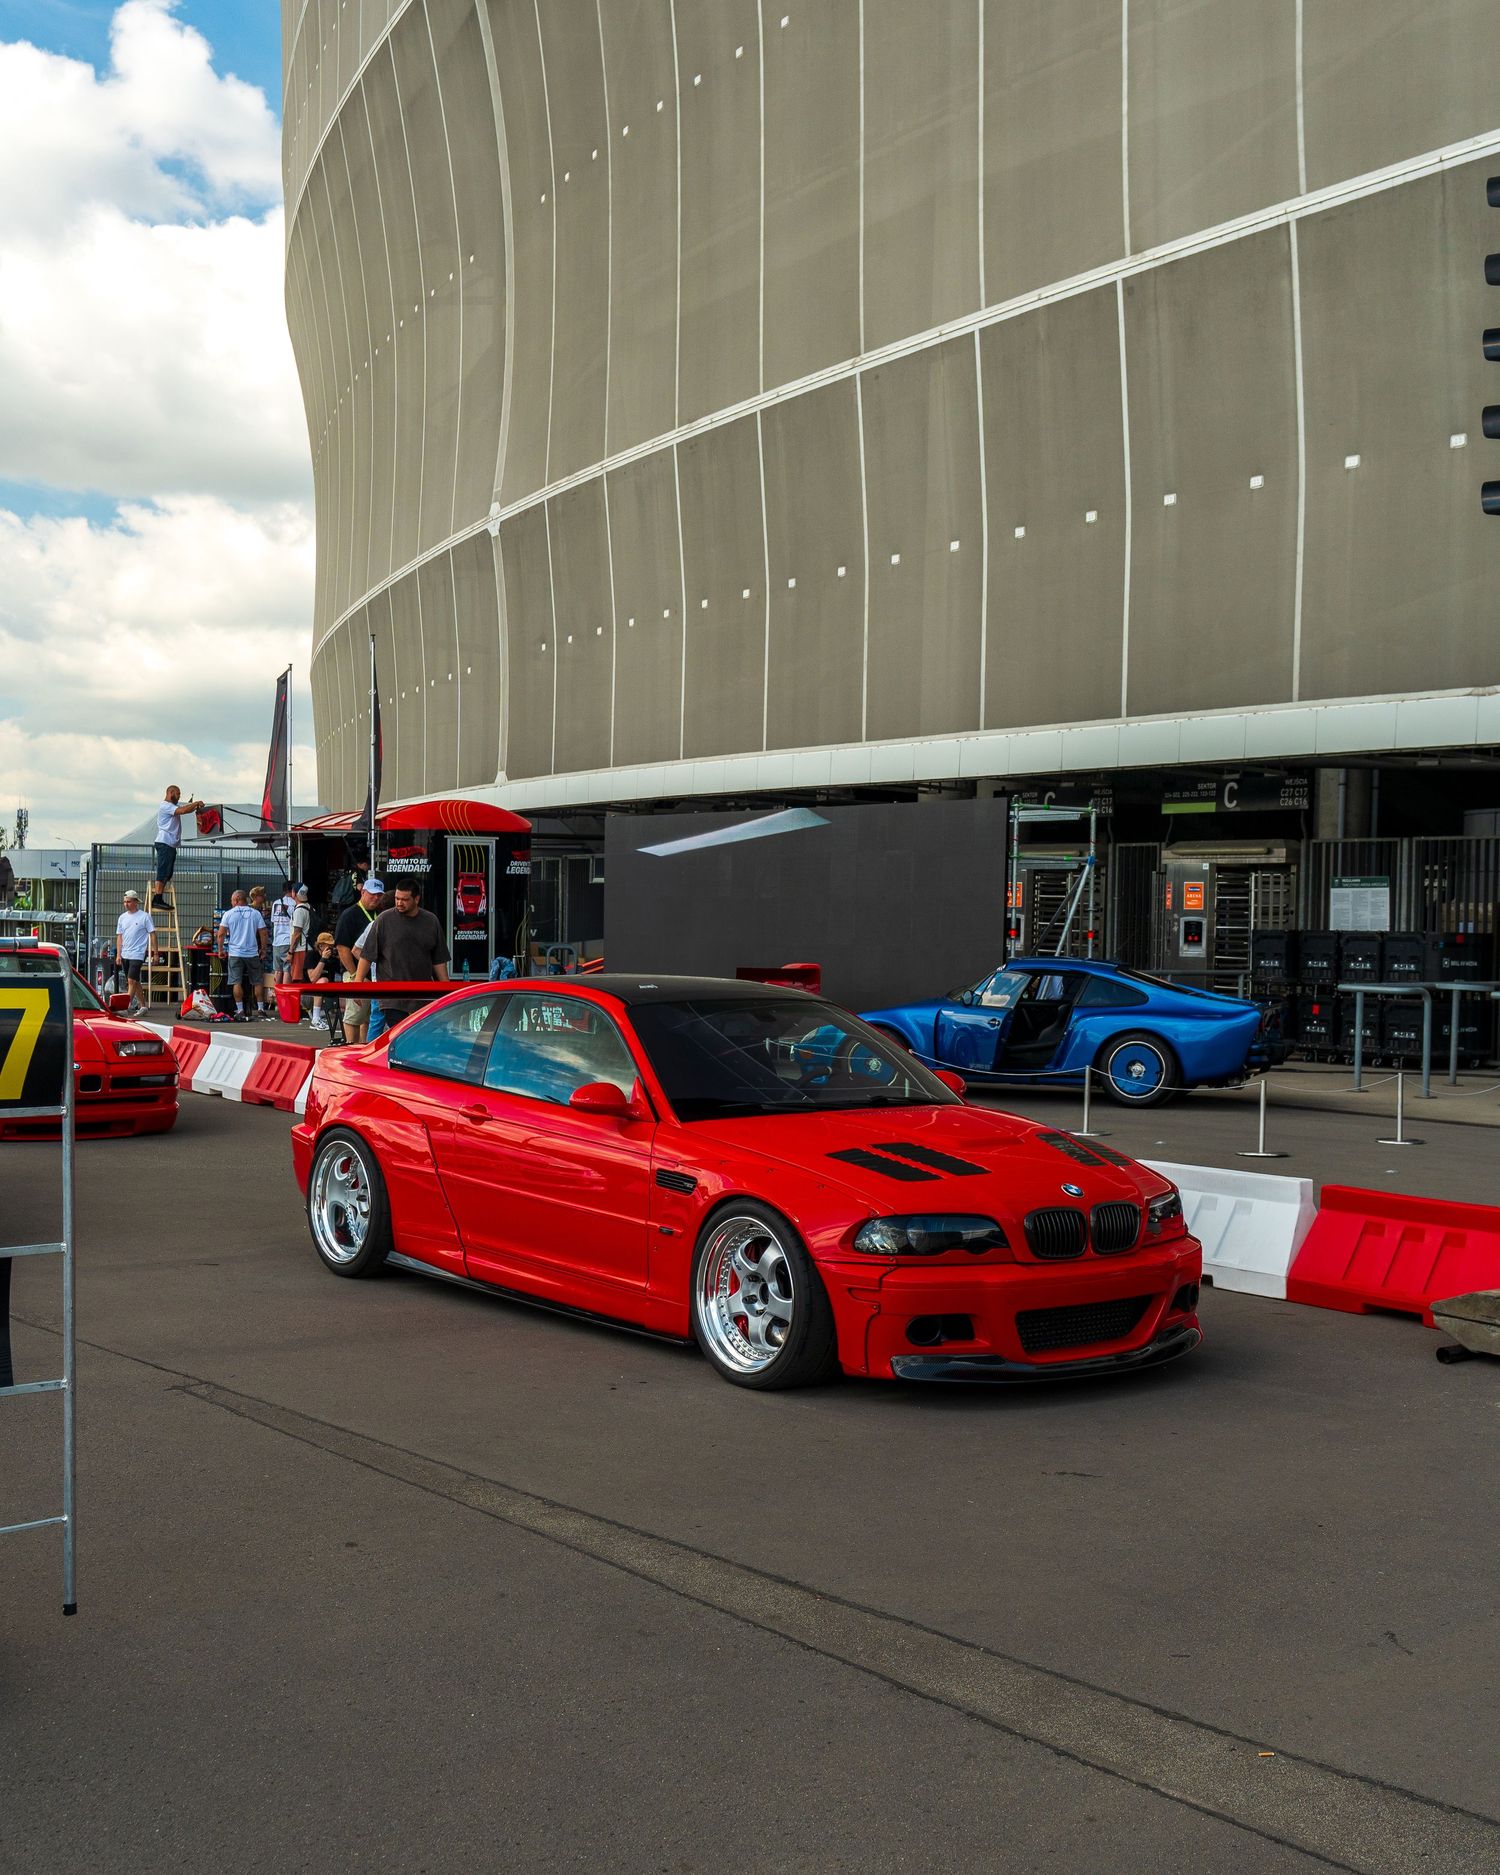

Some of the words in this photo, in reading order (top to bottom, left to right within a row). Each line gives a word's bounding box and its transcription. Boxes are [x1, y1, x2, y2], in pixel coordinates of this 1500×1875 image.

[1223, 782, 1239, 808] C
[1280, 788, 1293, 796] C27
[1294, 788, 1308, 796] C17
[1280, 798, 1293, 806] C26
[1294, 798, 1308, 806] C16
[386, 864, 432, 873] LEGENDARY
